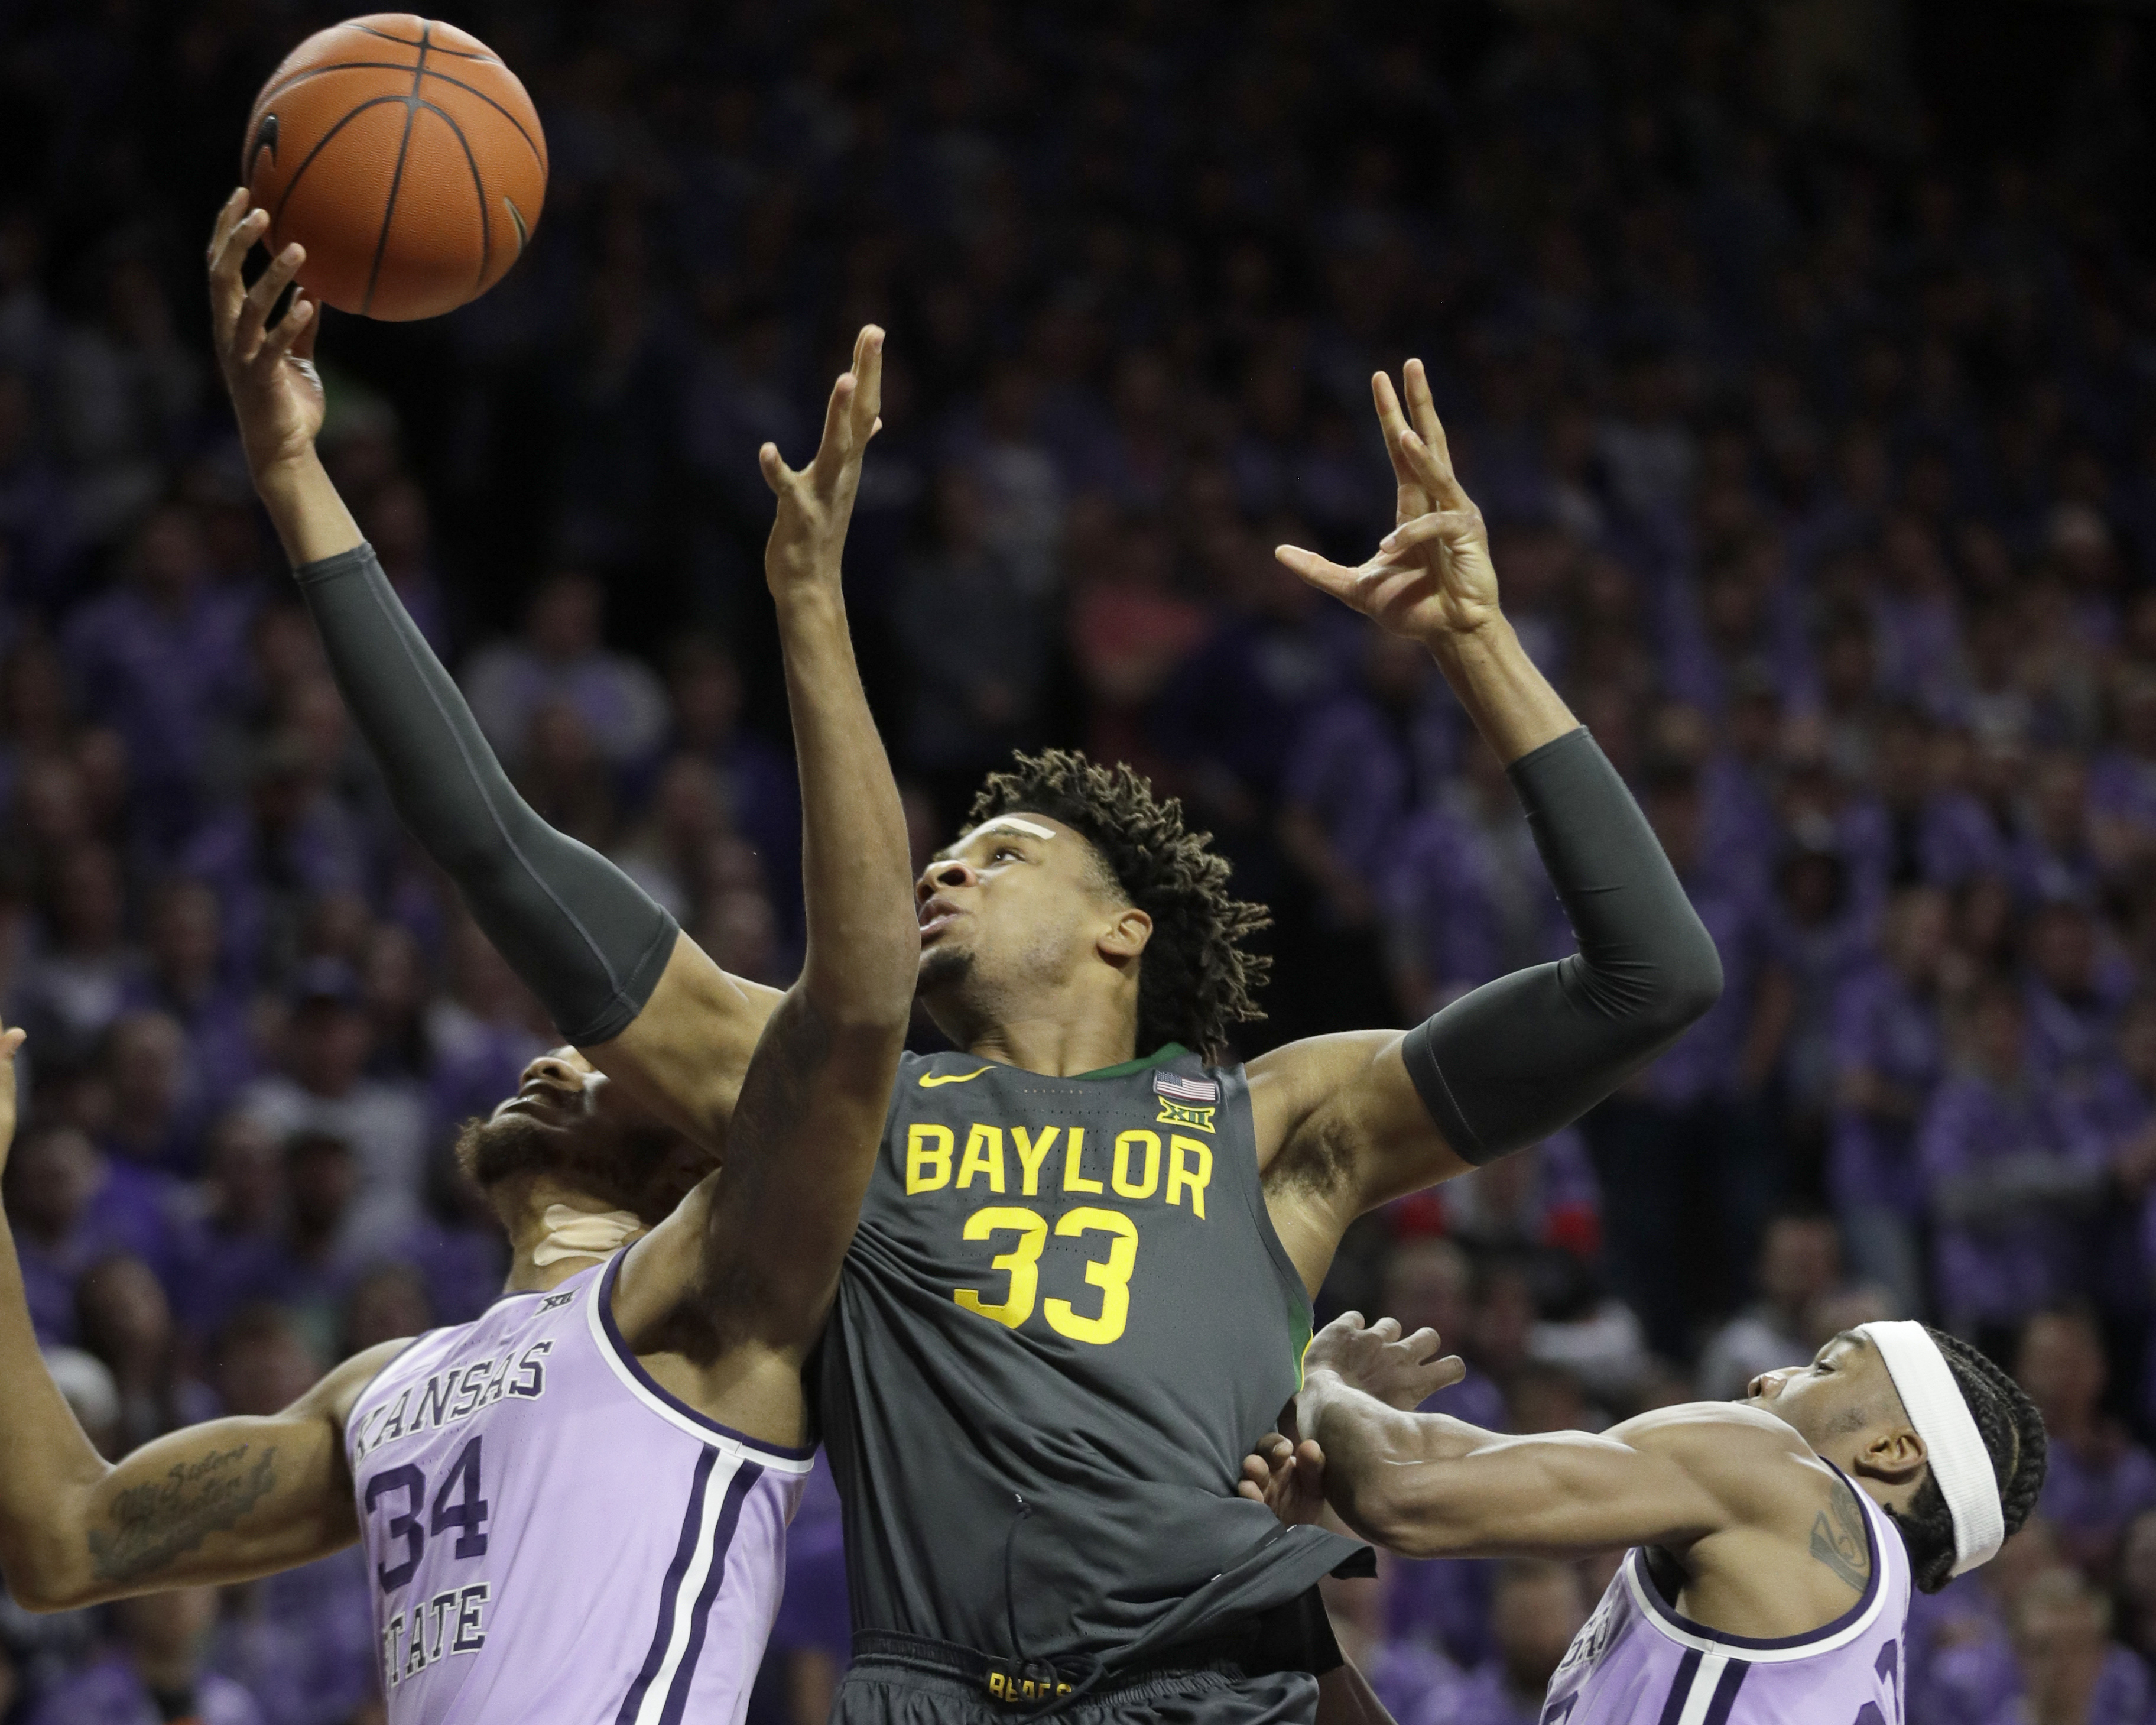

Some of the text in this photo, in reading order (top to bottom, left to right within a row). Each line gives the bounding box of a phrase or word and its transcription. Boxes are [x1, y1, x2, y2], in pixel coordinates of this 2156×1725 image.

[907, 1124, 1213, 1220] BAYLOR
[954, 1207, 1138, 1345] 33
[355, 1340, 553, 1467] KANSAS
[365, 1435, 488, 1593] 34
[384, 1581, 491, 1688] TATE
